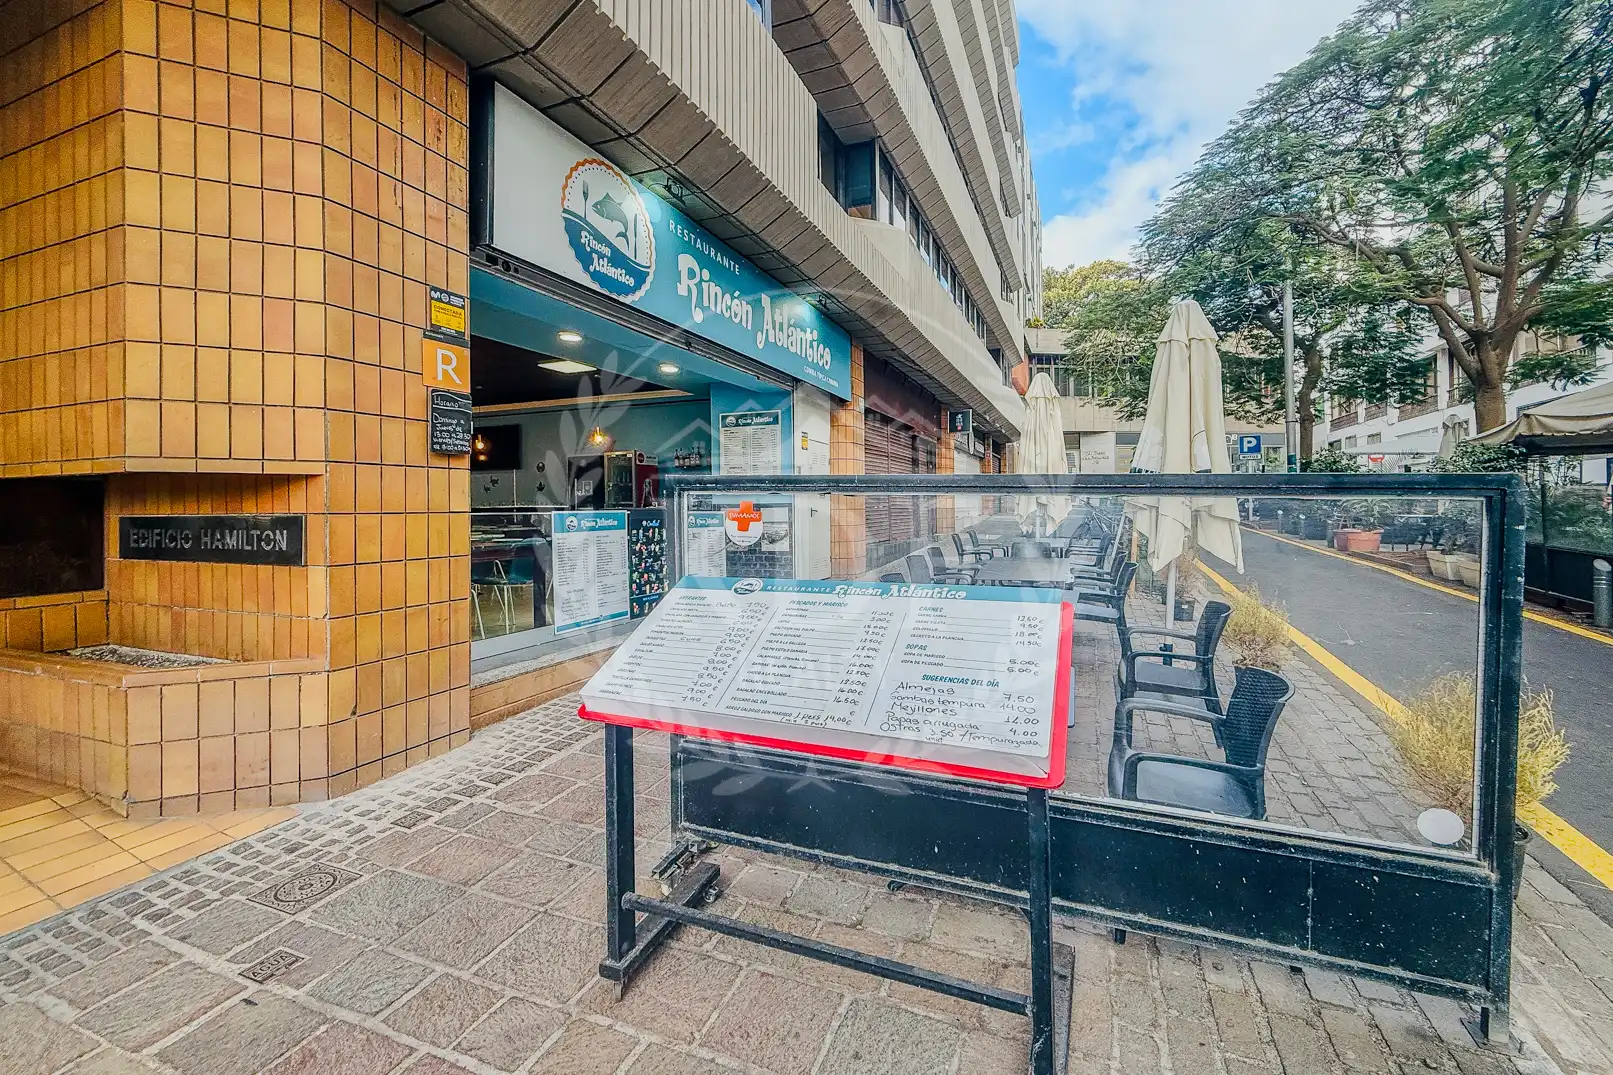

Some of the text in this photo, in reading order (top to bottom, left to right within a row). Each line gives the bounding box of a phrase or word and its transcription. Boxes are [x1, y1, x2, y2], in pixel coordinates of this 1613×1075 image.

[580, 230, 611, 257] Rincón
[669, 219, 740, 275] RESTAURANTE
[589, 252, 635, 287] Atlántico
[677, 253, 832, 370] Rincón Atlántico
[436, 347, 462, 385] R
[1243, 437, 1257, 452] P
[129, 529, 288, 551] EDIFICIO HAMILTON
[766, 583, 967, 600] RESTAURANTE Rincón Atlántico
[905, 643, 928, 651] SOPAS
[921, 673, 1000, 688] SUGERENCIAS DEL DÍA
[889, 690, 935, 705] Gambas
[937, 696, 986, 710] tempura
[895, 681, 1034, 703] Almejas 7.50
[879, 721, 921, 733] Ostras
[886, 710, 920, 727] Papas
[1009, 727, 1038, 737] 4.00
[251, 954, 288, 978] AGUA
